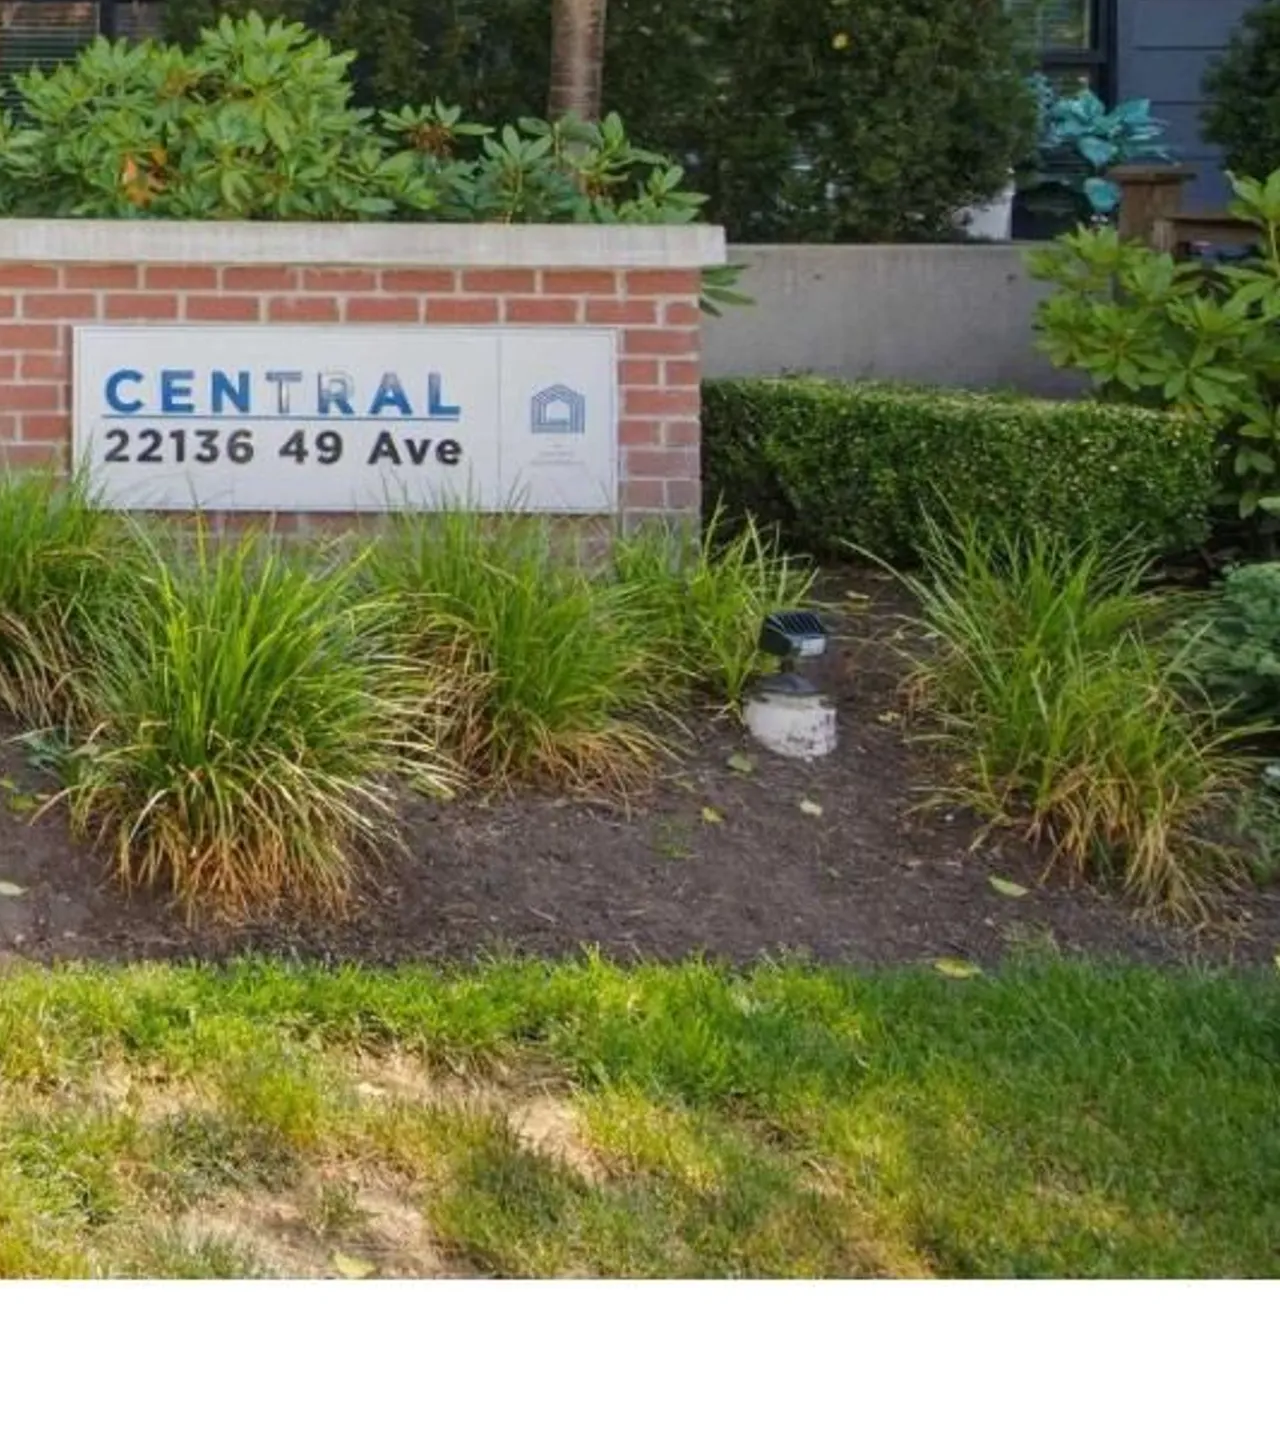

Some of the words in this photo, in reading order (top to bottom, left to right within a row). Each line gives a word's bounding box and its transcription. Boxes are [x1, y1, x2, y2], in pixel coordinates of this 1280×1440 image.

[106, 369, 461, 414] CENTRAL
[105, 428, 254, 465] 22136
[278, 429, 343, 465] 49
[367, 430, 462, 465] Ave
